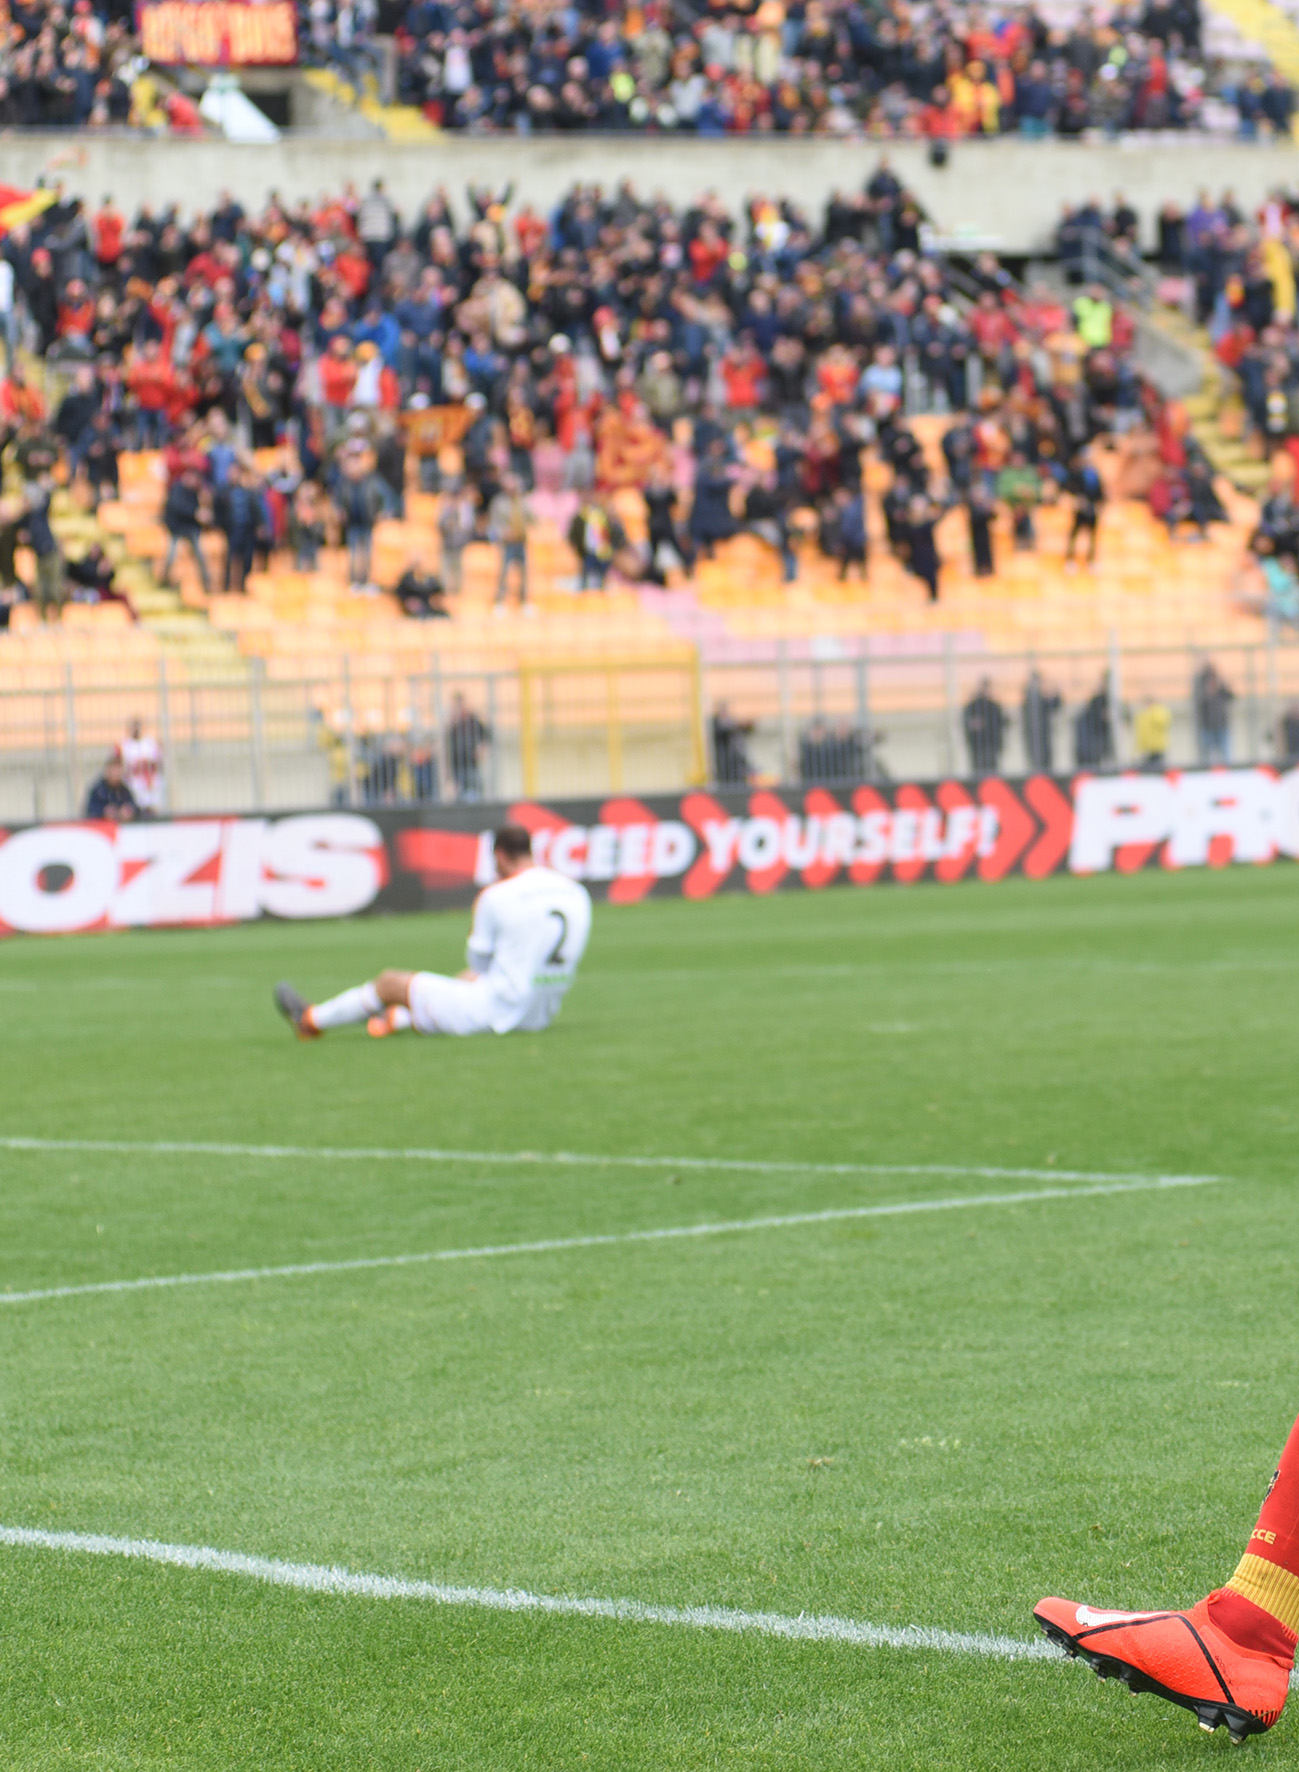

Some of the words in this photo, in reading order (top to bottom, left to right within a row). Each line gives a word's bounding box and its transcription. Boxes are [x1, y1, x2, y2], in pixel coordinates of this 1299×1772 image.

[701, 804, 1000, 873] YOURSELF!
[547, 909, 569, 966] 2
[1250, 1528, 1277, 1545] CCE
